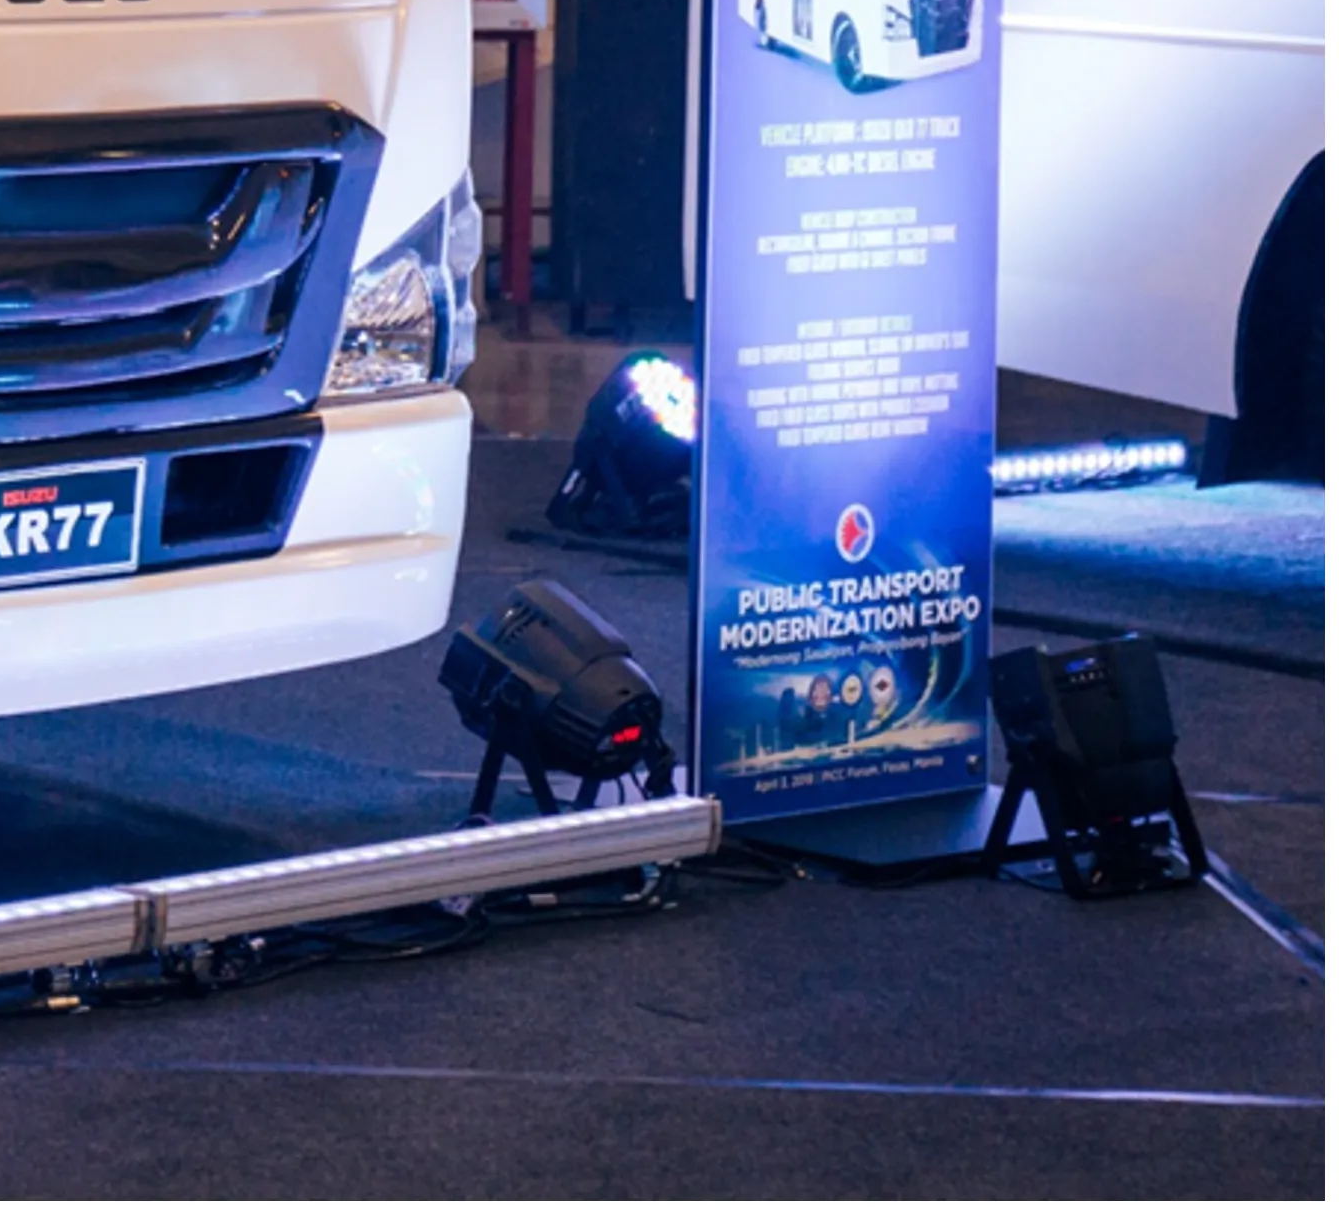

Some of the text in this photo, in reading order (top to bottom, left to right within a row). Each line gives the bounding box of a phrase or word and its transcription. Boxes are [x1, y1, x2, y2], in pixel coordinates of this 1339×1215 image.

[2, 486, 58, 507] ISUZU
[738, 566, 965, 616] PUBLIC TRANSPORT
[720, 595, 982, 650] MODERNIZATION EXPO
